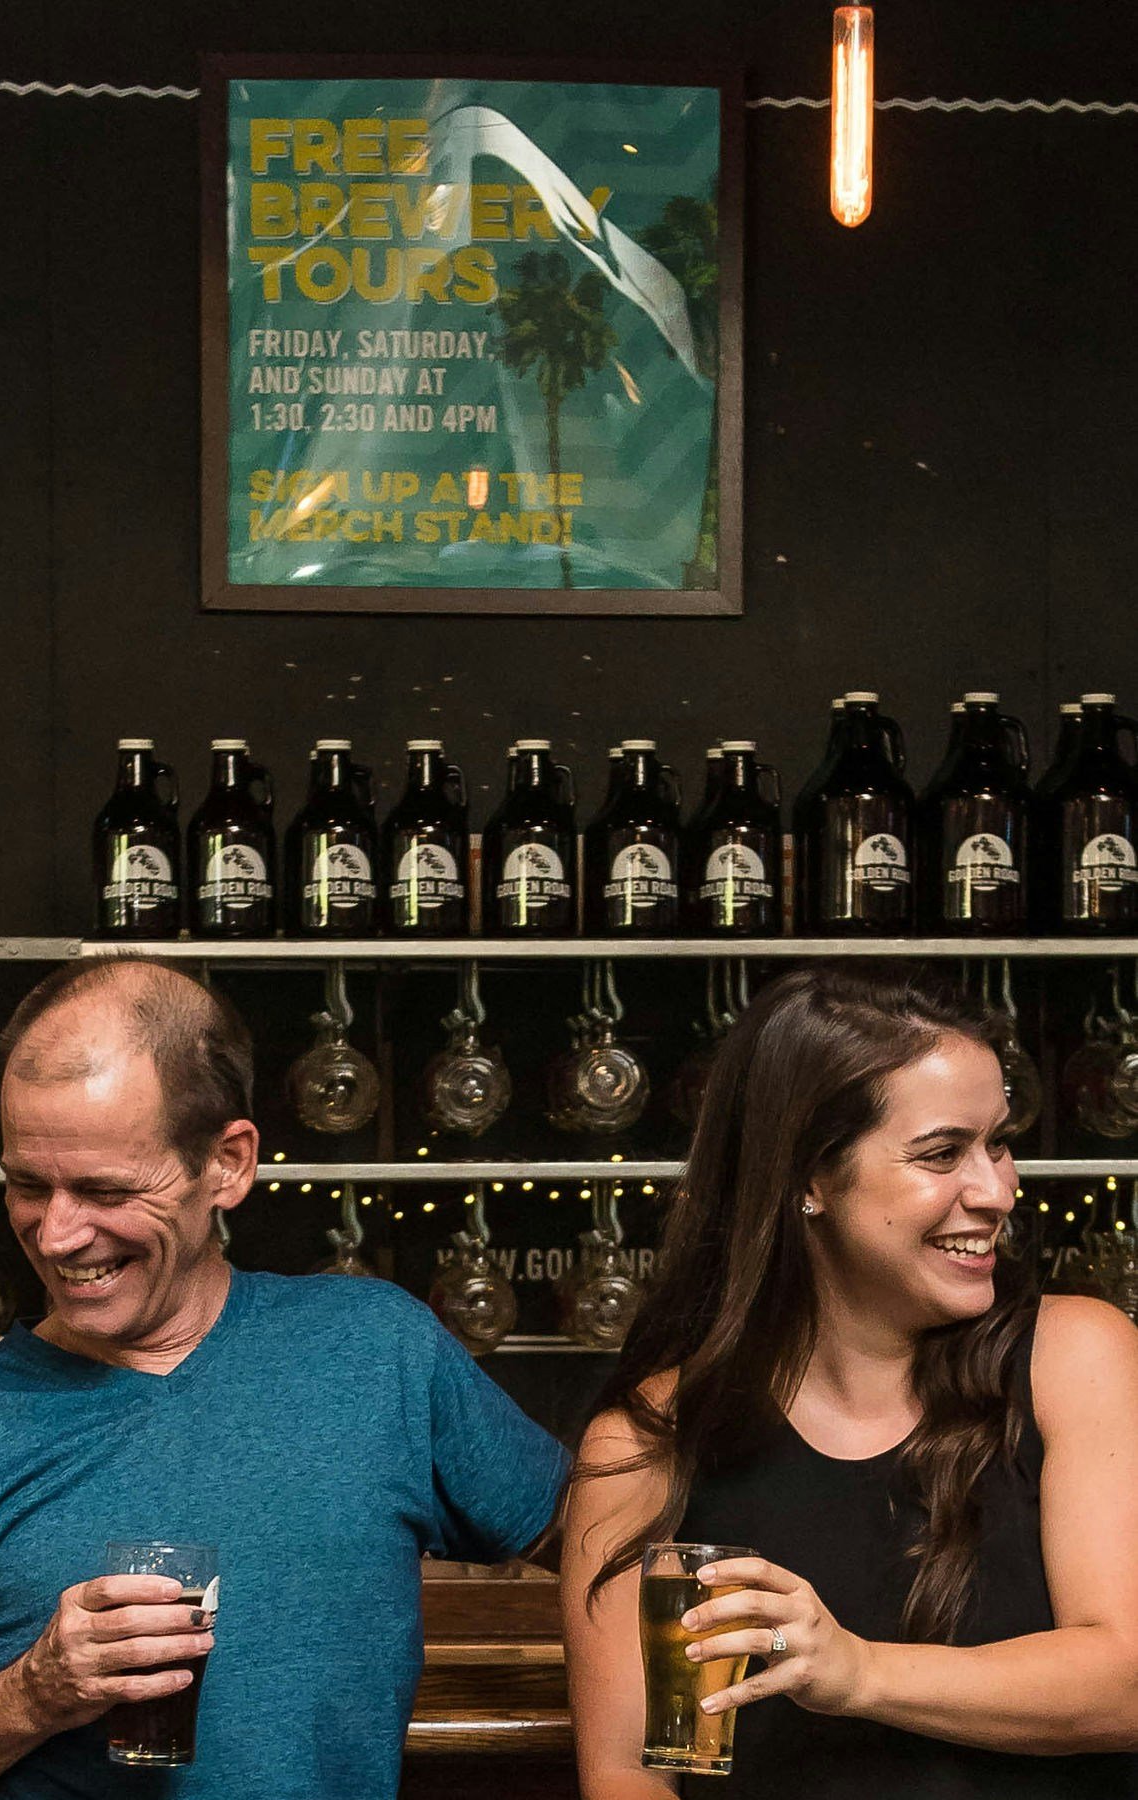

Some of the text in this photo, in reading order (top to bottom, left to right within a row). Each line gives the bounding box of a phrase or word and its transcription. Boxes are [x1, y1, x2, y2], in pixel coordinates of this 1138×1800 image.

[250, 118, 431, 175] FREE
[248, 247, 499, 305] TOURS
[358, 331, 496, 363] SATURDAY,
[248, 366, 447, 395] AND SUNDAY AT
[321, 403, 375, 432] 2:30
[382, 405, 435, 432] AND
[441, 405, 498, 433] 4PM
[249, 469, 350, 502] SIGN
[362, 472, 420, 504] UP
[498, 472, 584, 506] THE
[249, 510, 574, 546] MERCH STAND!
[303, 880, 351, 899] GODEN
[389, 880, 435, 898] GOLEN
